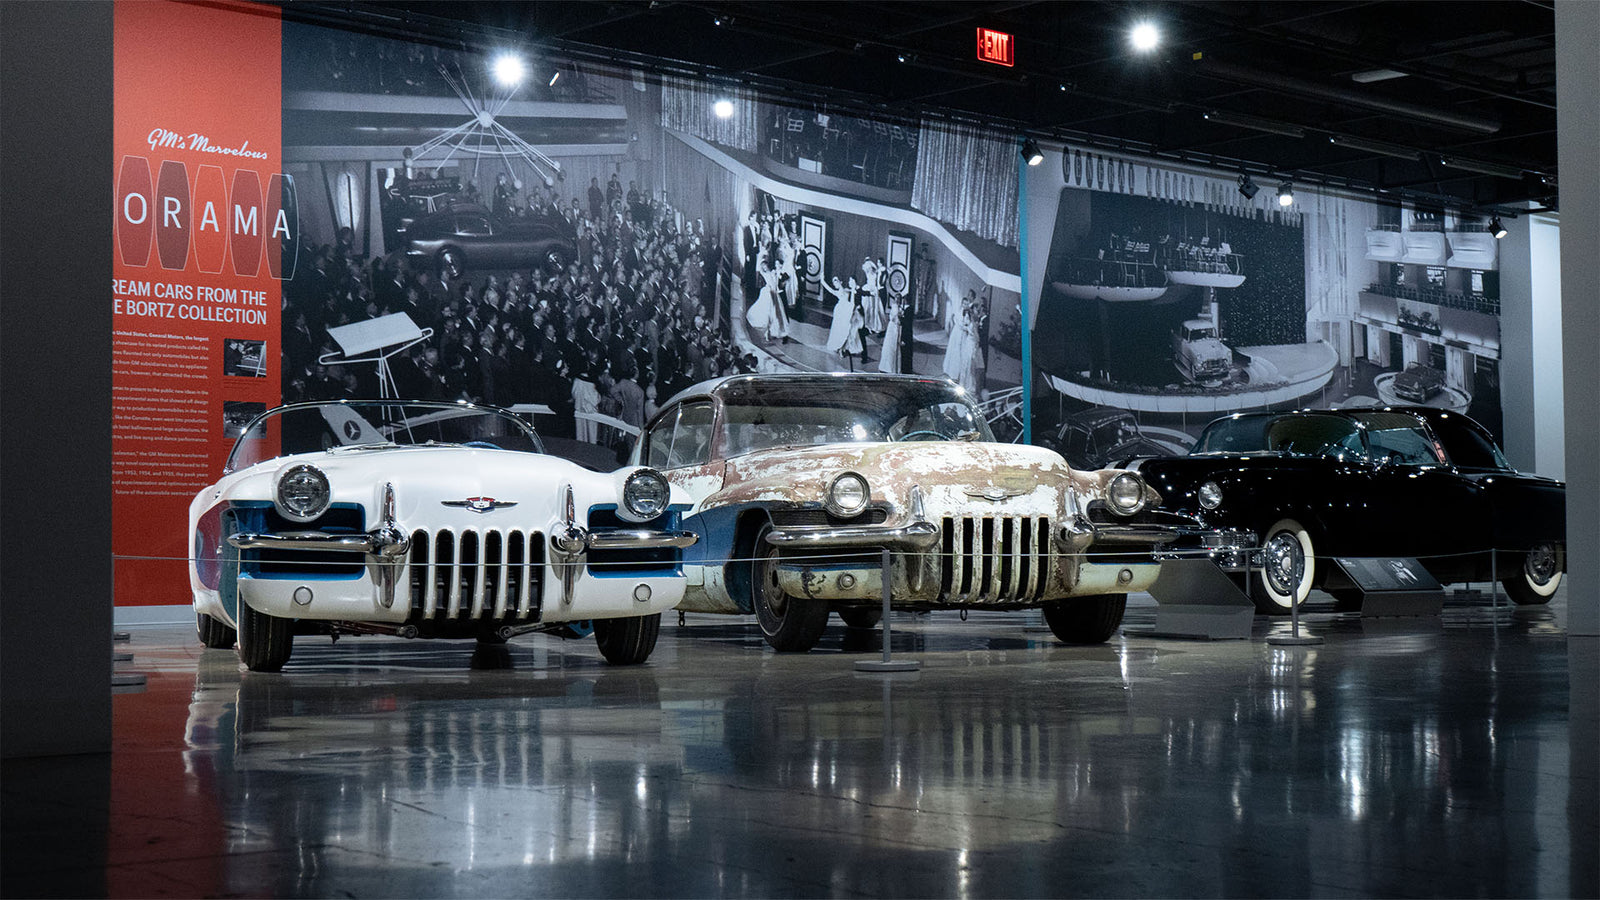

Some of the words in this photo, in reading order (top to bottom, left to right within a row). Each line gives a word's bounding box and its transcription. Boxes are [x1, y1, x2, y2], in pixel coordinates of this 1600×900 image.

[984, 30, 1009, 62] EXIT
[147, 128, 186, 151] GM's
[188, 133, 267, 160] Marvelous
[123, 192, 292, 240] ORAMA
[112, 279, 151, 297] REAM
[154, 282, 194, 301] CARS
[197, 286, 238, 304] FROM
[240, 289, 267, 306] THE
[114, 299, 123, 315] E
[126, 300, 176, 319] BORTZ
[178, 304, 267, 325] COLLECTION
